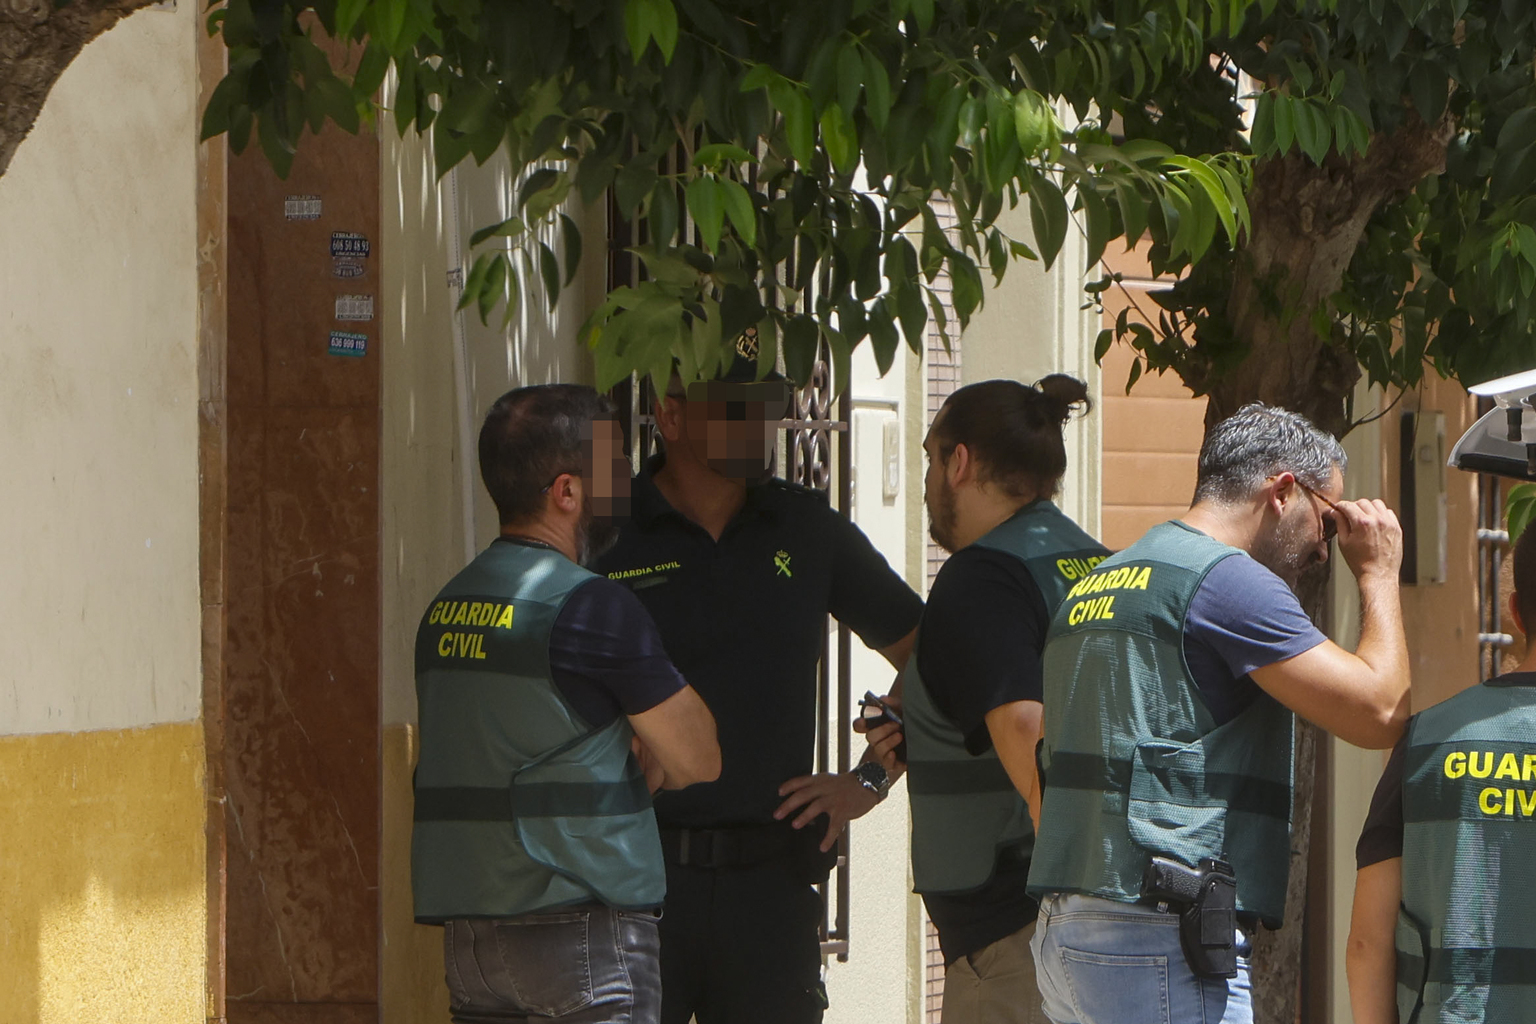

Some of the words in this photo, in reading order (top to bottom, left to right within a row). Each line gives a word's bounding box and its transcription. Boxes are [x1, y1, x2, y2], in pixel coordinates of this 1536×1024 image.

[608, 567, 653, 580] GUARDIA
[654, 561, 681, 571] CIVIL
[1066, 566, 1152, 601] GUARDIA
[428, 601, 515, 629] GUARDIA
[1068, 596, 1115, 626] CIVIL
[438, 632, 487, 659] CIVIL
